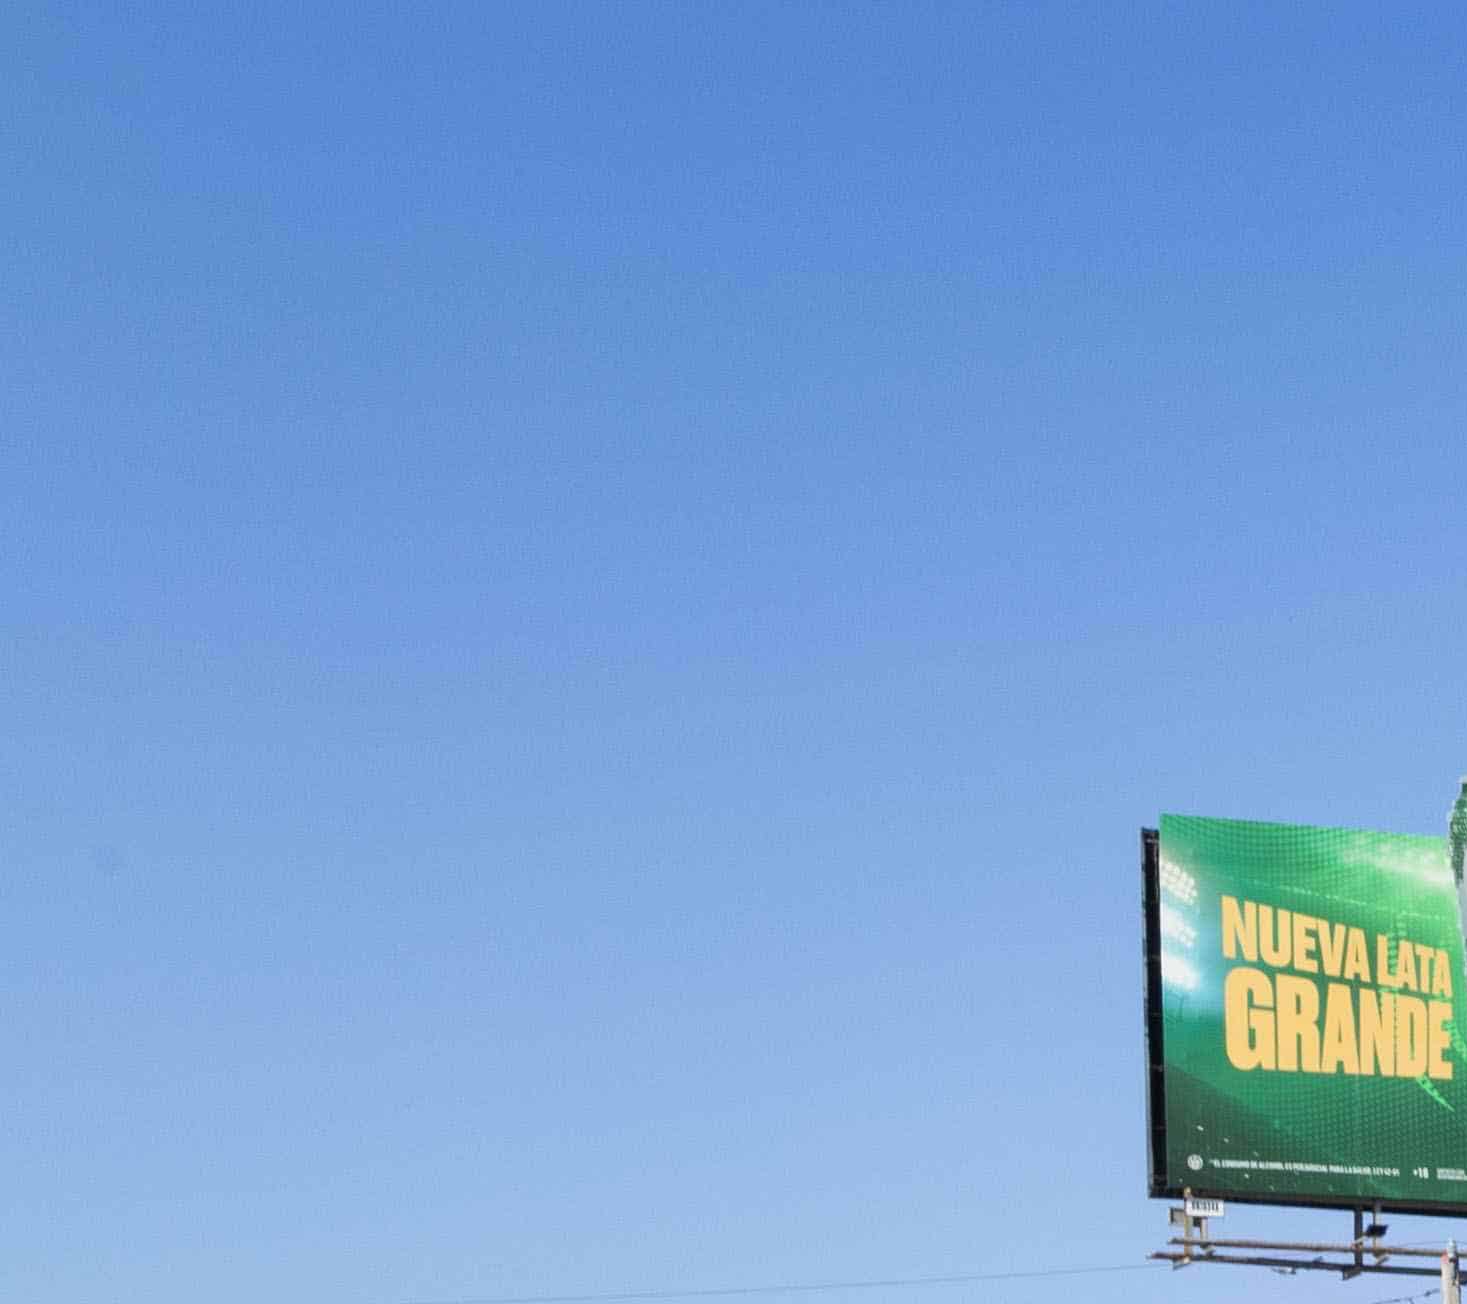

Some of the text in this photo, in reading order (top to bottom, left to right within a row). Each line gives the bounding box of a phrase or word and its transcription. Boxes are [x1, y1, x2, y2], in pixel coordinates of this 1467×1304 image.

[1222, 895, 1453, 998] NUEVA LATA
[1225, 966, 1453, 1080] GRANDE
